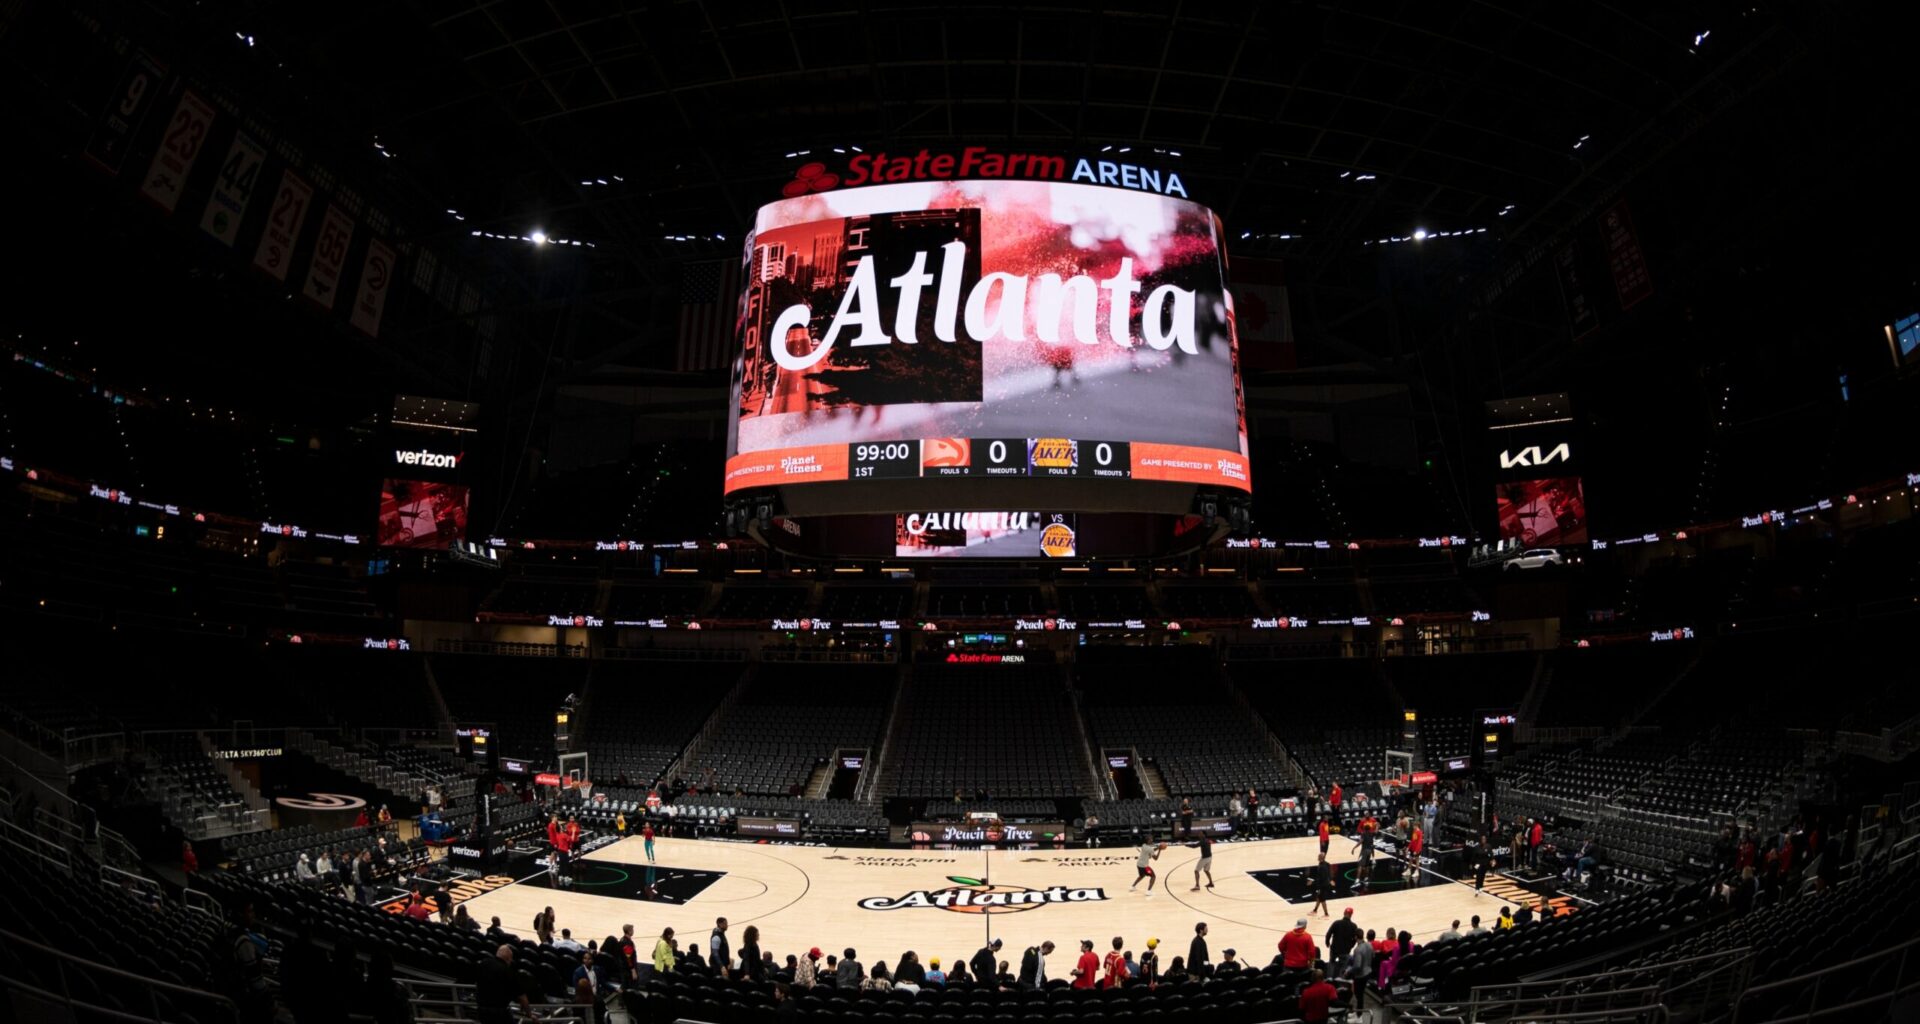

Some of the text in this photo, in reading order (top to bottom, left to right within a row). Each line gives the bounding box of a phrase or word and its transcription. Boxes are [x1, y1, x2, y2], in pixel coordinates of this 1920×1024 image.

[165, 109, 205, 160] 23
[218, 150, 261, 201] 44
[844, 147, 1188, 198] State Farm ARENA
[272, 187, 304, 235] 21
[319, 220, 348, 266] 55
[770, 240, 1200, 371] Atlanta
[856, 443, 909, 461] 99:00
[989, 440, 1007, 463] 0
[1095, 442, 1113, 465] 0
[1500, 443, 1569, 469] KIA
[396, 449, 456, 468] verizon
[780, 455, 816, 469] planet
[1141, 458, 1161, 467] GAME
[1162, 460, 1202, 470] PRESENTED
[766, 463, 775, 472] BY
[785, 464, 823, 475] fitness
[855, 467, 874, 477] 1ST
[940, 467, 960, 475] FOULS
[986, 467, 1017, 475] TIMEOUTS
[1217, 459, 1242, 473] planet
[1093, 469, 1123, 477] TIMEOUTS
[1050, 514, 1064, 523] VS
[595, 541, 618, 551] Peach
[627, 540, 644, 551] Tree
[1226, 538, 1250, 549] Peach
[1259, 538, 1276, 549] Tree
[1450, 535, 1466, 546] Tree
[548, 614, 574, 627] Peach
[585, 615, 604, 627] Tree
[772, 618, 799, 630] Peach
[811, 618, 831, 629] Tree
[1014, 618, 1044, 630] Peach
[1056, 618, 1077, 629] Tree
[1251, 616, 1278, 629] Peach
[1289, 616, 1308, 628] Tree
[959, 652, 980, 663] State
[1001, 654, 1025, 663] ARENA
[214, 750, 239, 759] DELTA
[1003, 825, 1033, 840] Tree
[452, 845, 481, 859] verizon
[857, 886, 1112, 911] Atlanta
